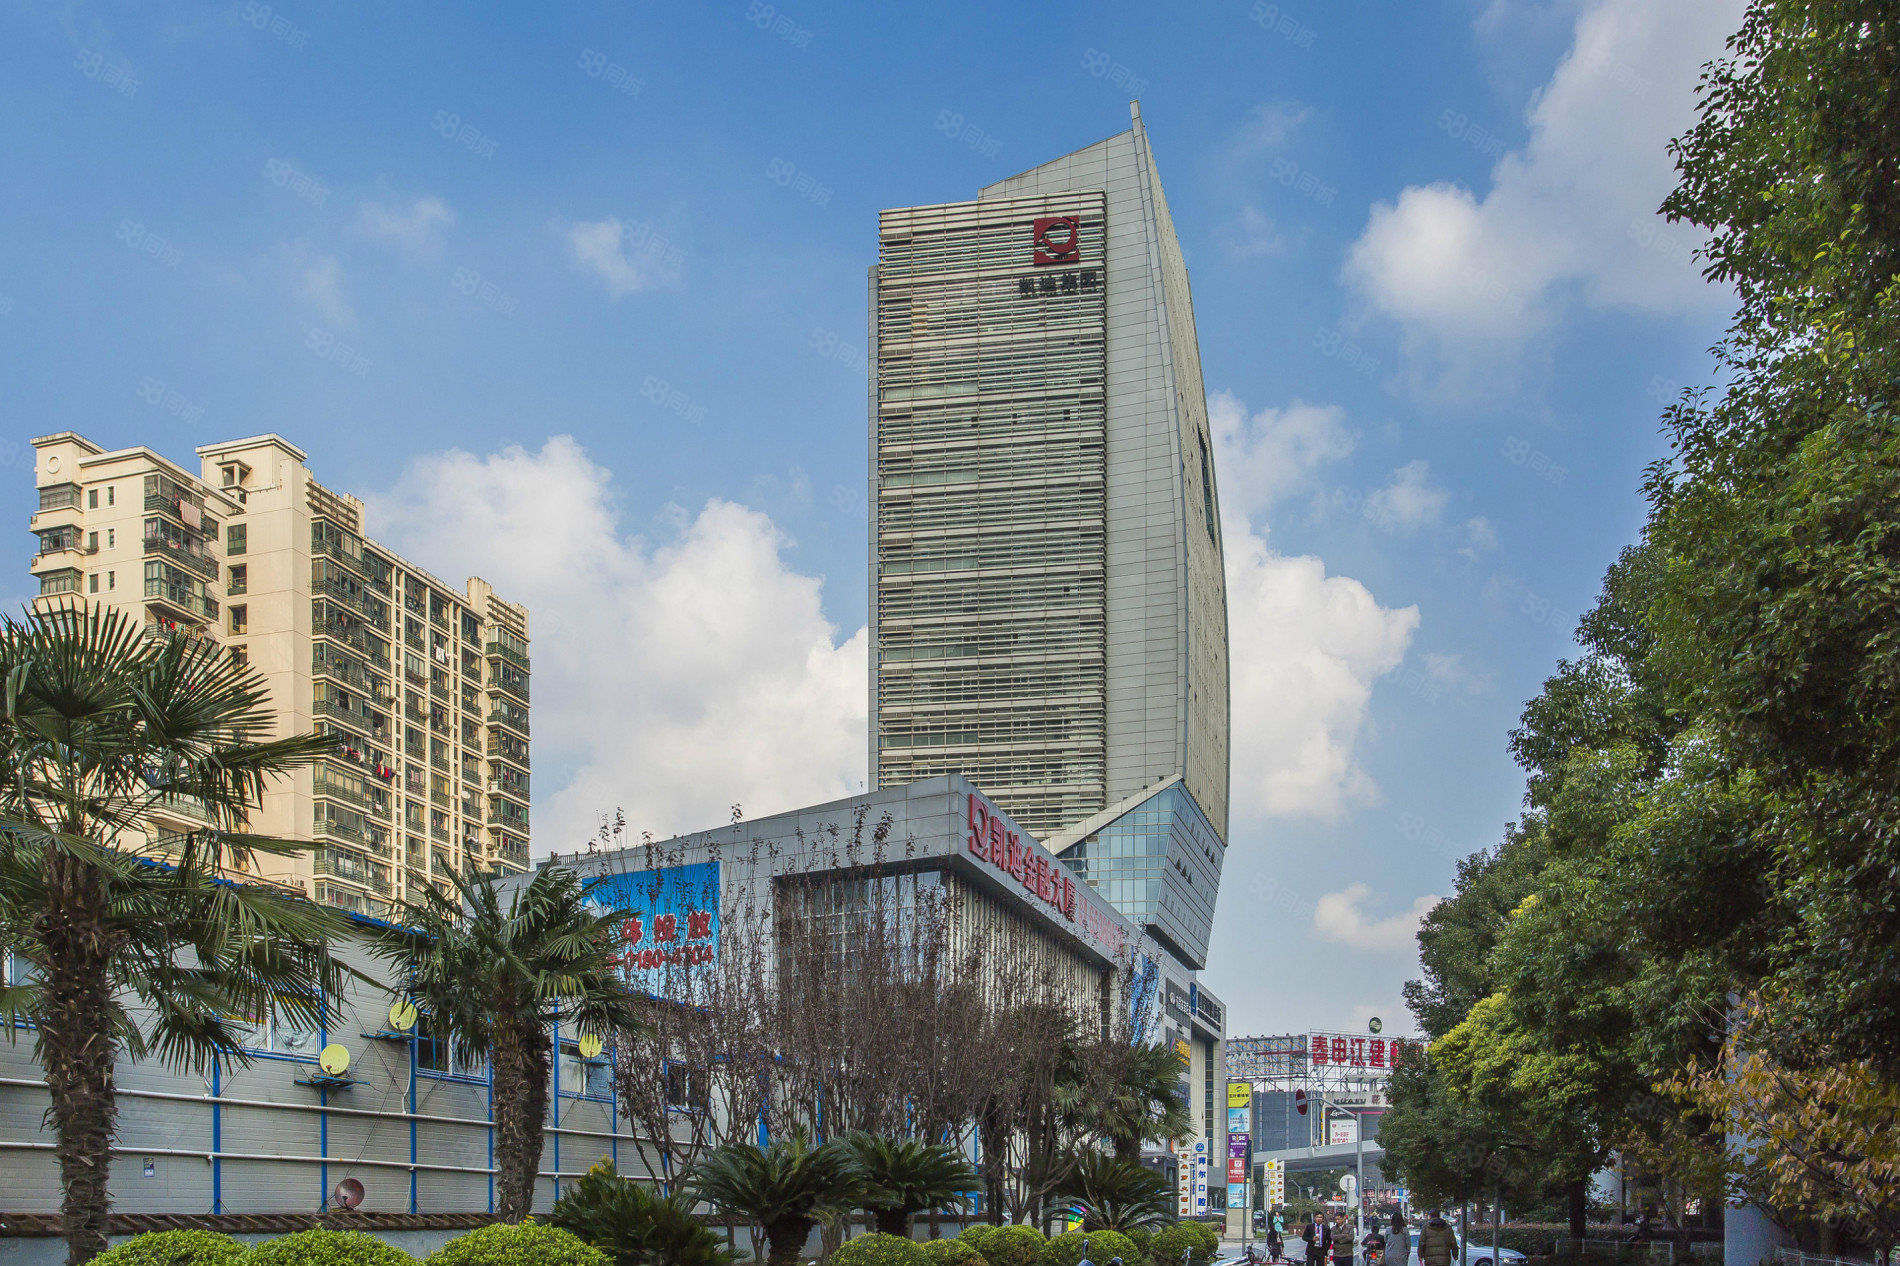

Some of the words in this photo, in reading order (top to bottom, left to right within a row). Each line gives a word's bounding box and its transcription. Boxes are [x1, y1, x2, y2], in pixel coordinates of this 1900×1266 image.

[990, 815, 1077, 923] 凯迪金融大厦
[1197, 1157, 1207, 1207] 拜尔口腔
